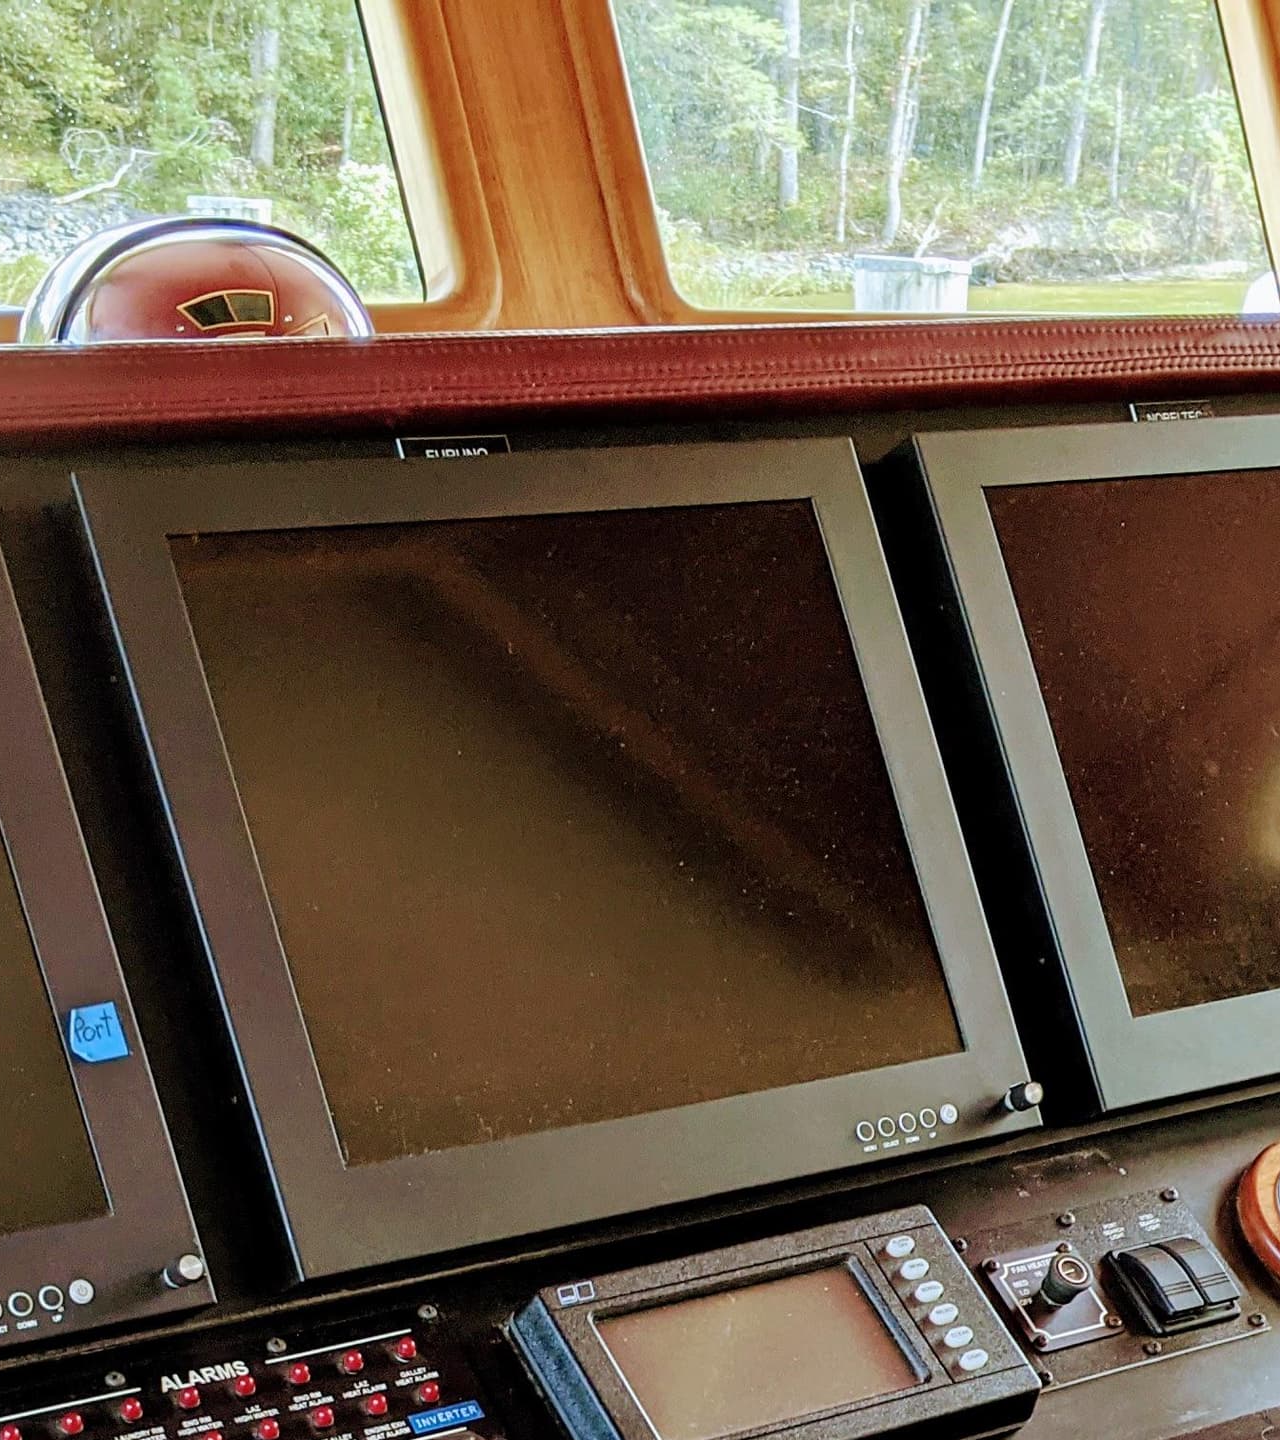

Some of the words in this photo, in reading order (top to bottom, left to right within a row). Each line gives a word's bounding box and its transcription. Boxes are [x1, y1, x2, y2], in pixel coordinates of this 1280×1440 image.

[75, 1008, 113, 1043] Port
[1011, 1264, 1027, 1275] FAN
[160, 1360, 250, 1393] ALARMS
[395, 1377, 414, 1388] HEAT
[415, 1371, 439, 1383] ALARM
[399, 1366, 427, 1378] GALLEY
[342, 1388, 361, 1399] HEAT
[362, 1383, 387, 1395] ALARM
[353, 1380, 370, 1390] LAZ
[288, 1401, 307, 1412] HEAT
[308, 1395, 334, 1408] ALARM
[293, 1393, 308, 1404] ENG
[309, 1391, 322, 1400] RM
[234, 1413, 253, 1424] HIGH
[254, 1408, 280, 1421] WATER
[245, 1404, 261, 1414] LAZ
[415, 1404, 477, 1429] INVERTER
[177, 1425, 197, 1437] HIGH
[198, 1421, 224, 1433] WATER
[182, 1418, 197, 1428] ENG
[198, 1415, 212, 1425] RM
[385, 1426, 412, 1438] ALARM
